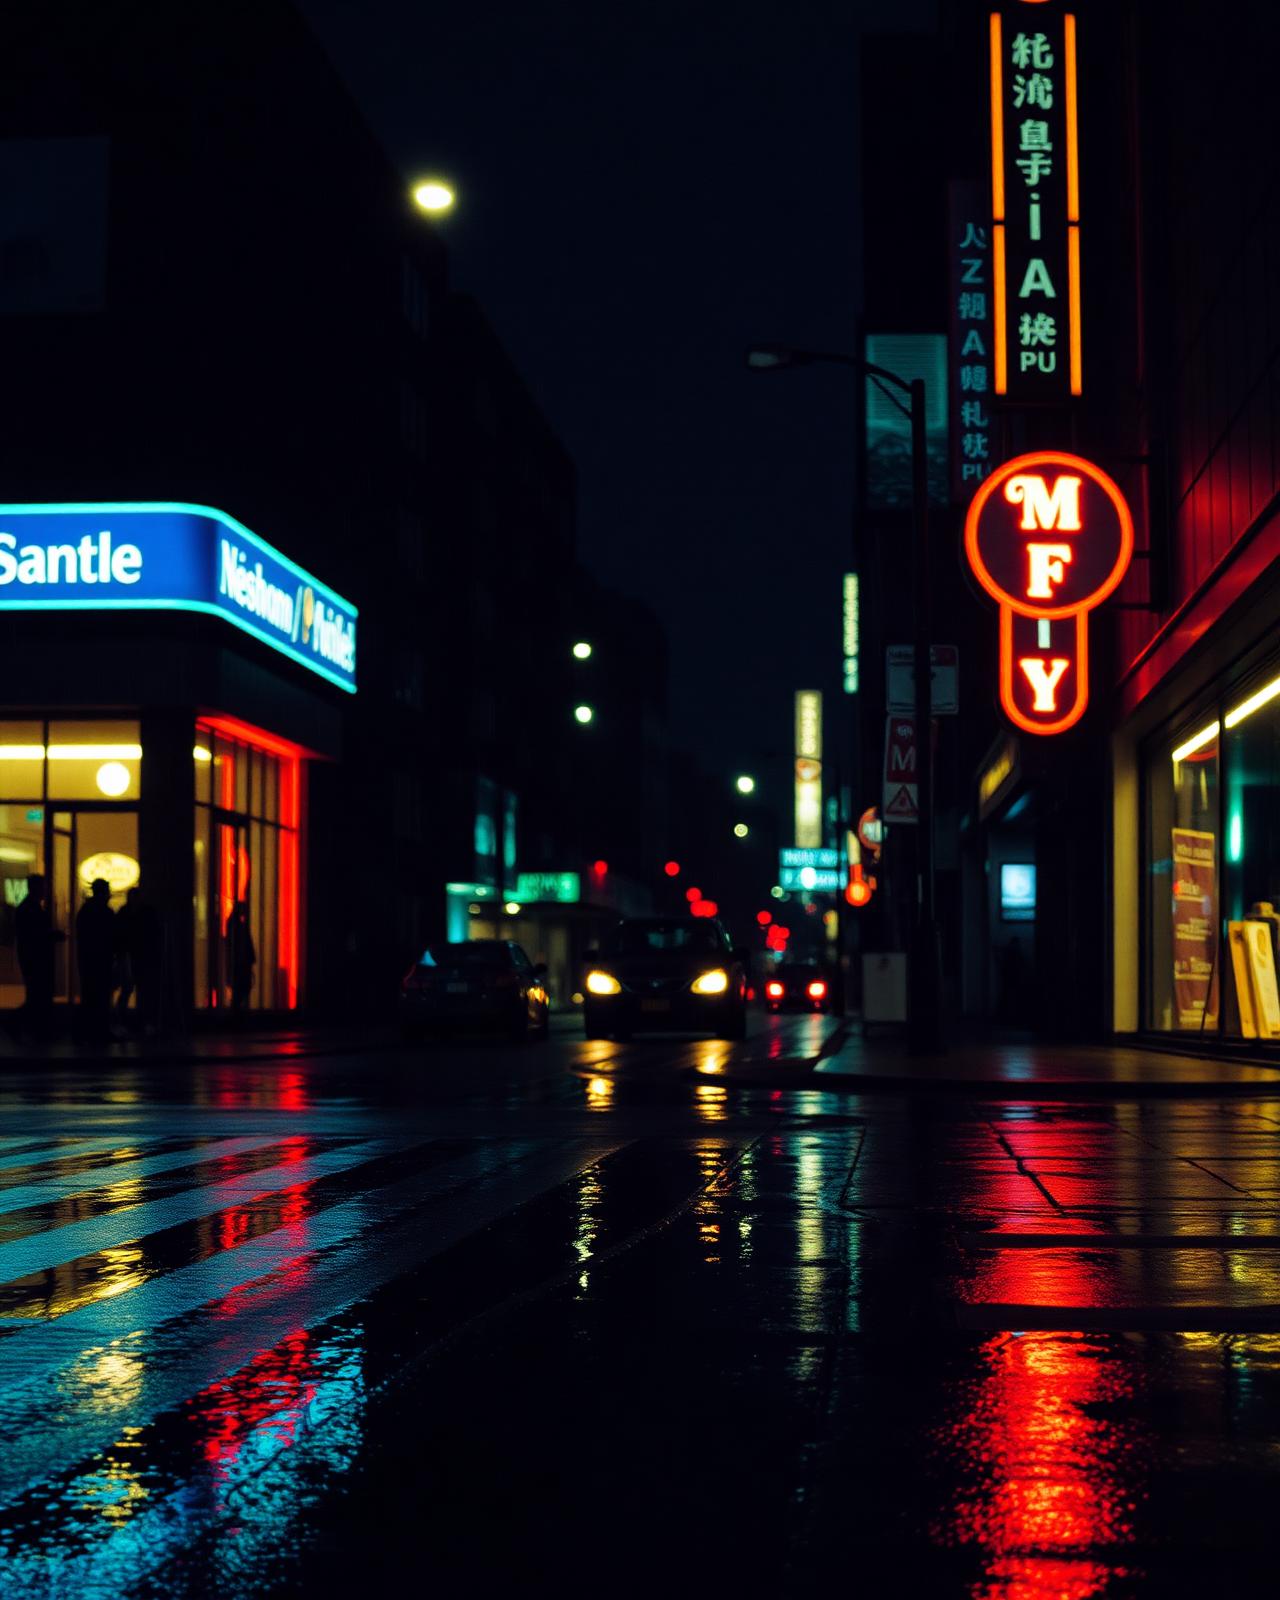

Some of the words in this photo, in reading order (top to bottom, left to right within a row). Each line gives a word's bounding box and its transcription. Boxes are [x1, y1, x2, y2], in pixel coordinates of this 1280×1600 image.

[1020, 351, 1056, 373] PU
[0, 531, 143, 585] Santle
[891, 744, 916, 772] M
